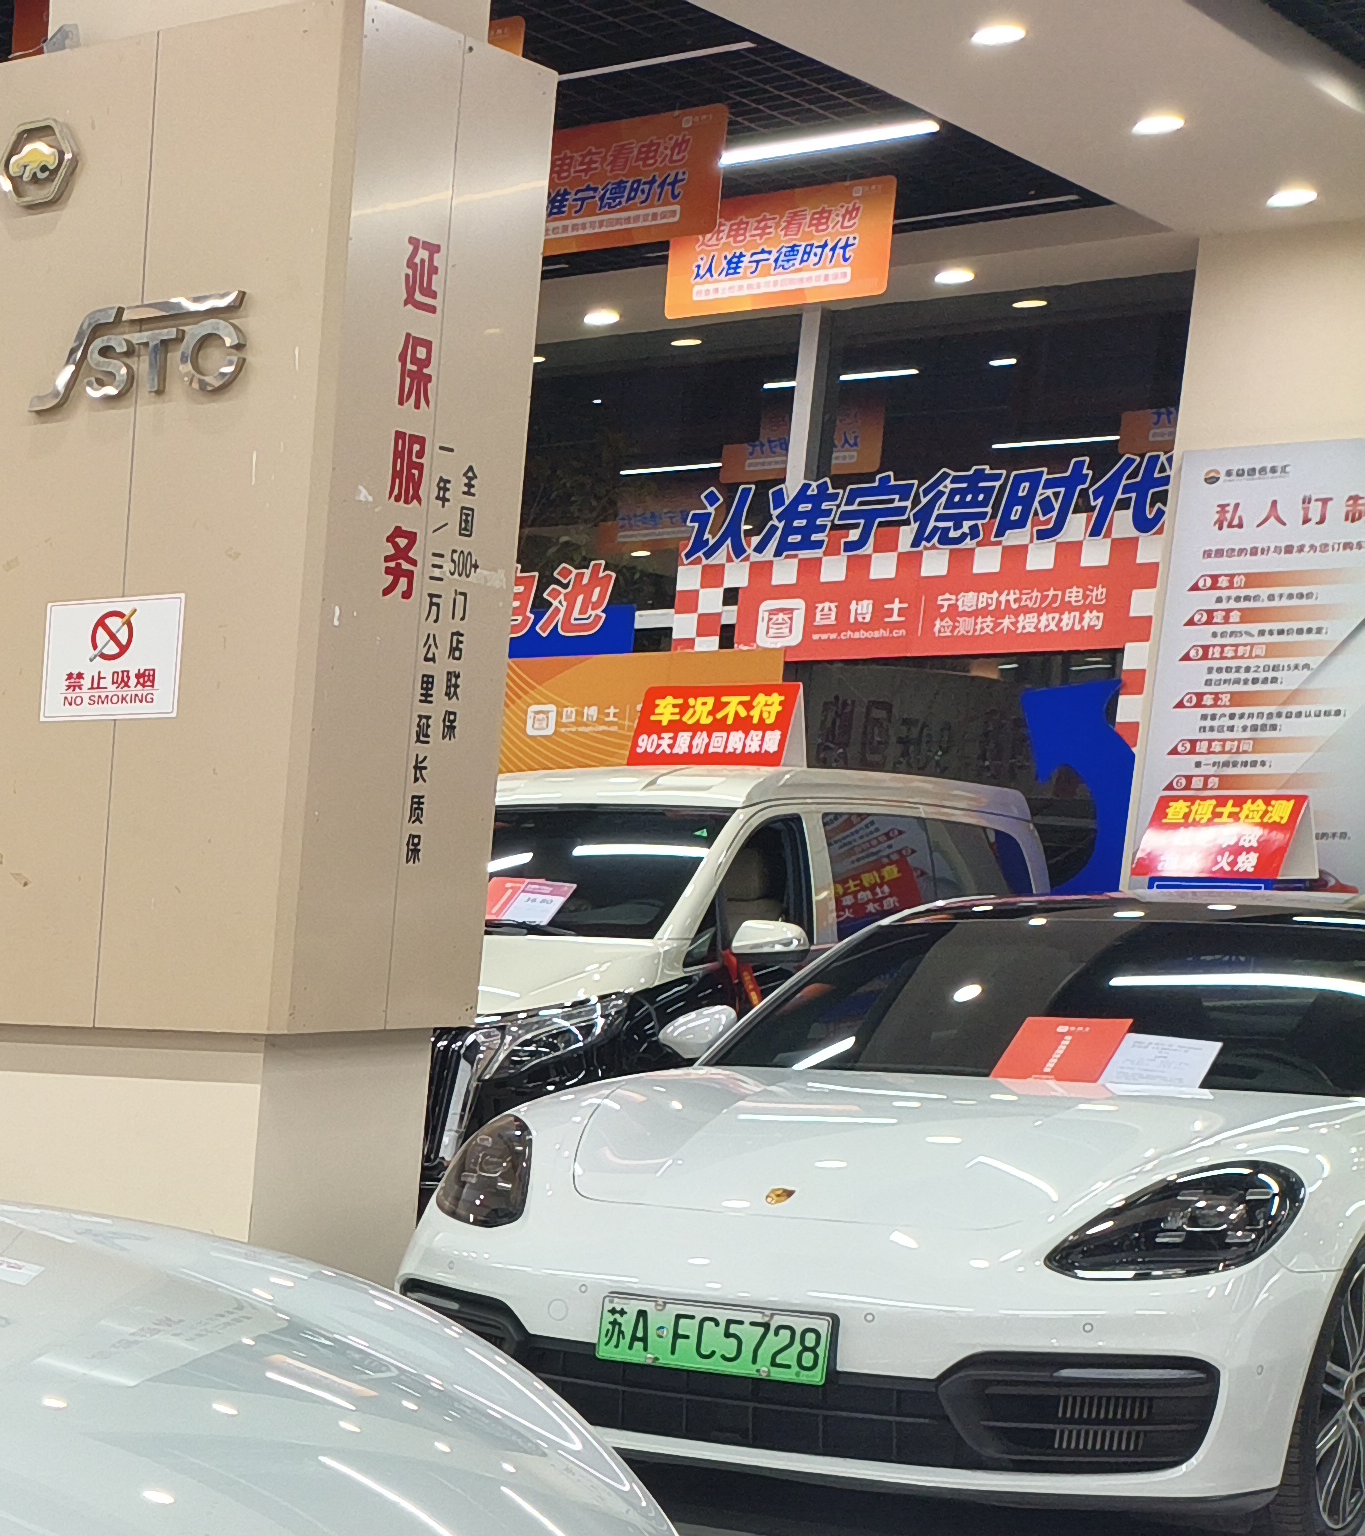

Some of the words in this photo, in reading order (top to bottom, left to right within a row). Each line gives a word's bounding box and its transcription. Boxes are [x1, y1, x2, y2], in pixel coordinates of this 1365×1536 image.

[605, 131, 692, 176] 看电池
[779, 200, 863, 239] 看电池
[691, 235, 859, 283] 认准宁德时代
[382, 235, 441, 600] 延保服务
[683, 451, 1173, 563] 认准宁德时代
[1217, 575, 1246, 588] 车价
[441, 464, 480, 741] 全国500+门店联保
[812, 598, 908, 627] 查博士
[937, 585, 1106, 613] 宁德时代动力电池
[812, 628, 906, 640] www.chaboshi.cn
[934, 608, 1104, 637] 检测技术授权机构
[65, 668, 156, 692] 禁止吸烟
[63, 695, 84, 706] NO
[88, 693, 155, 706] SMOKING
[650, 693, 785, 726] 车况不符
[1201, 693, 1231, 706] 车况
[636, 730, 781, 755] 90天原价回购保障
[1161, 798, 1295, 825] 查博士检测
[1212, 851, 1259, 873] 火烧
